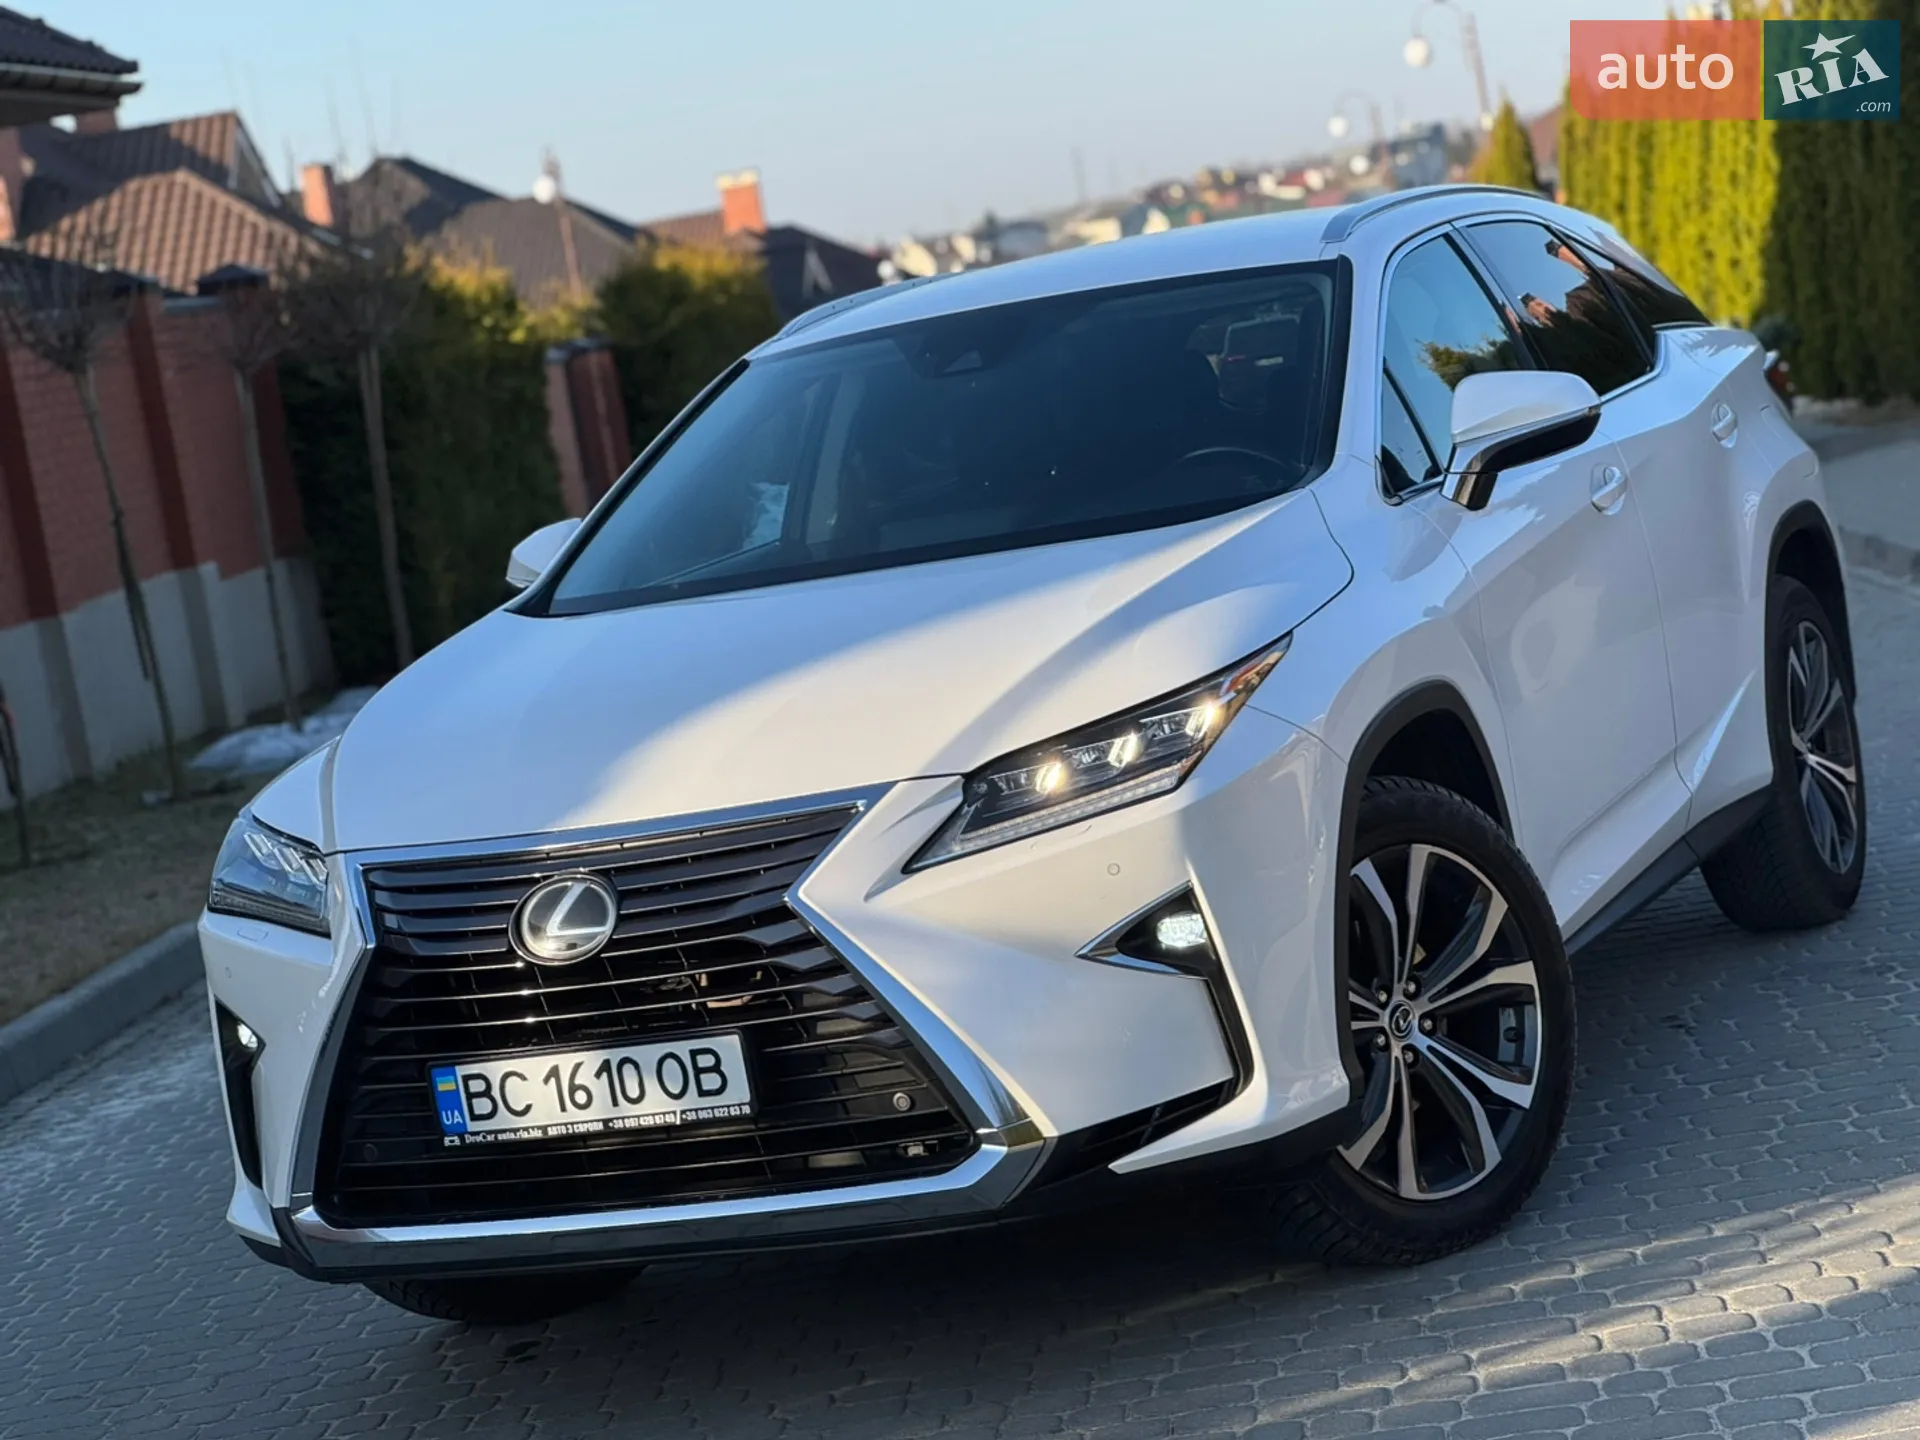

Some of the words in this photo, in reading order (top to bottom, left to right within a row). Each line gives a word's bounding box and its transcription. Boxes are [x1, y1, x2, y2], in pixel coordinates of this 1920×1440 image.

[461, 1070, 533, 1123] BC
[542, 1055, 646, 1114] 1610
[655, 1047, 728, 1101] OB
[442, 1109, 463, 1125] UA
